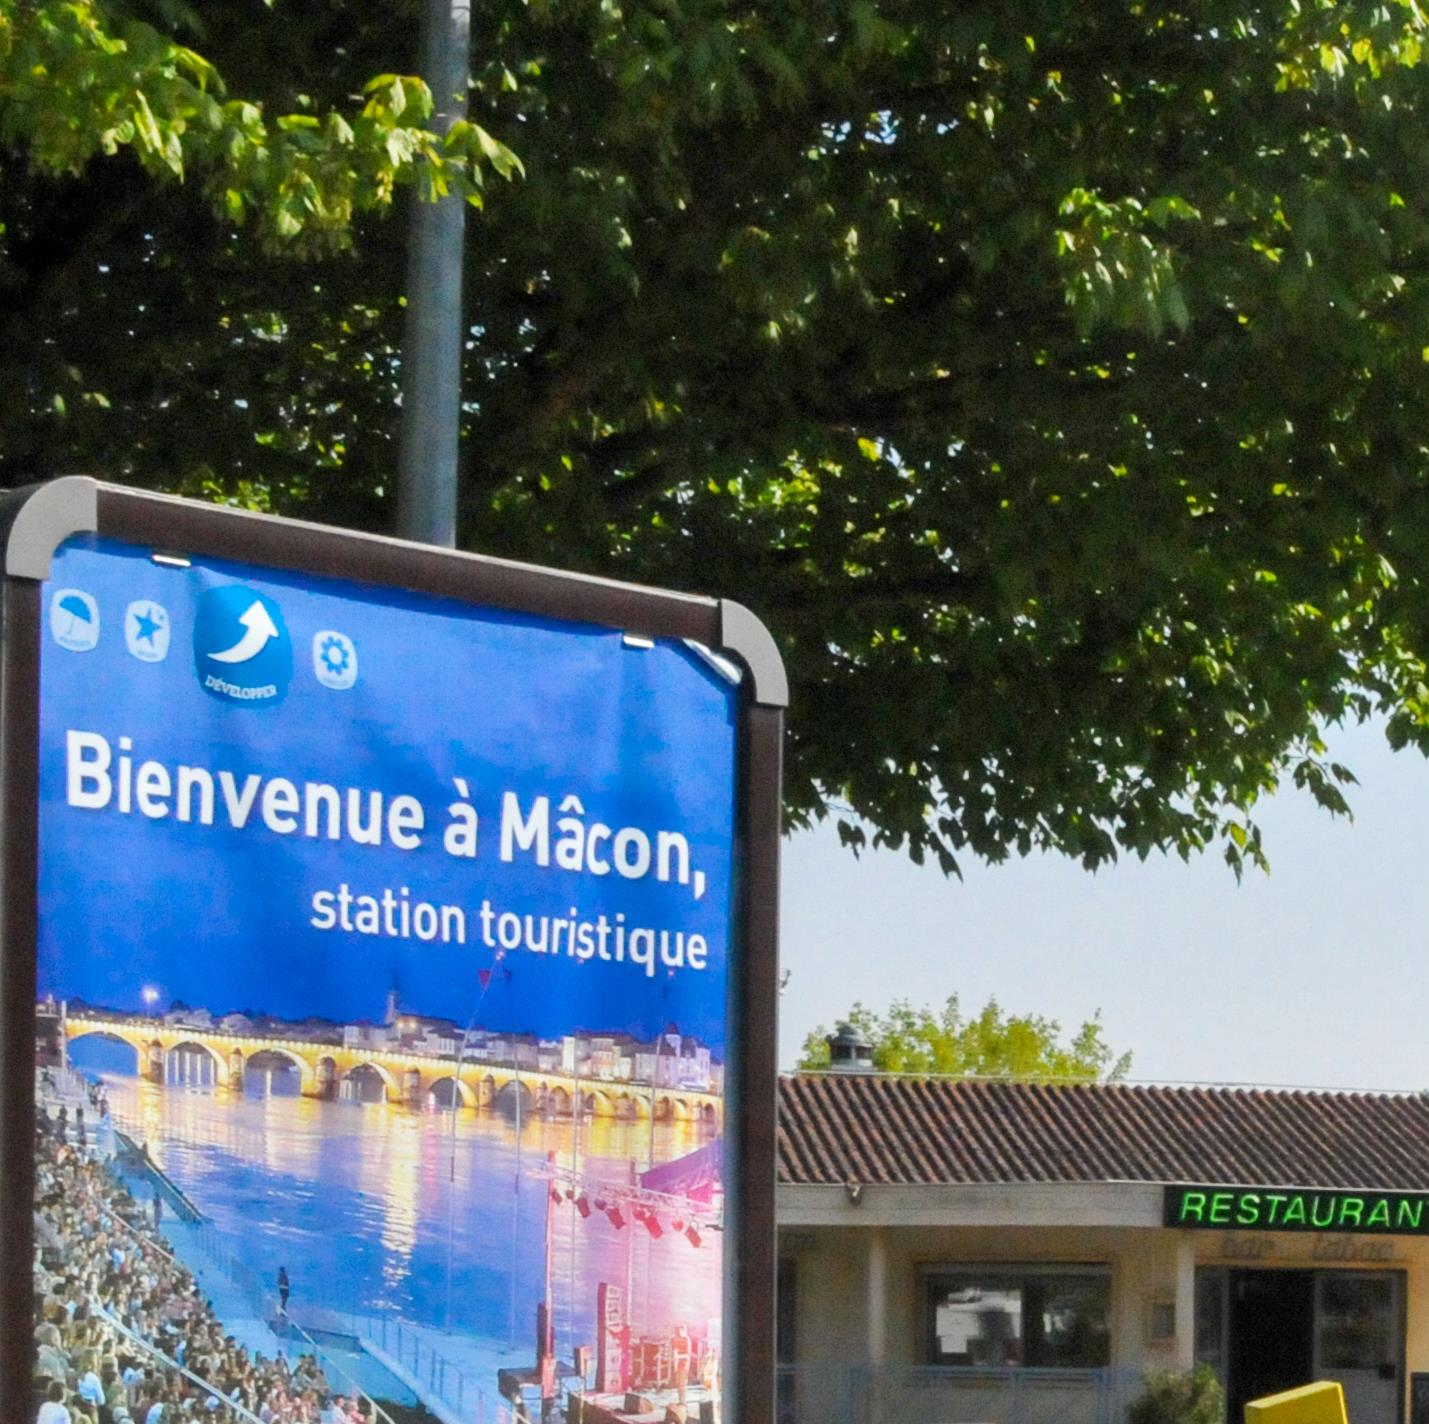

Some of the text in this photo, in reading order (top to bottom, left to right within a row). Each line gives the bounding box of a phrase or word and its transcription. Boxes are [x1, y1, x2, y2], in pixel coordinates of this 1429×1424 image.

[205, 674, 277, 699] DÉVELOPPER
[66, 729, 706, 900] Bienvenue à Mâcon,
[310, 883, 708, 978] station touristique
